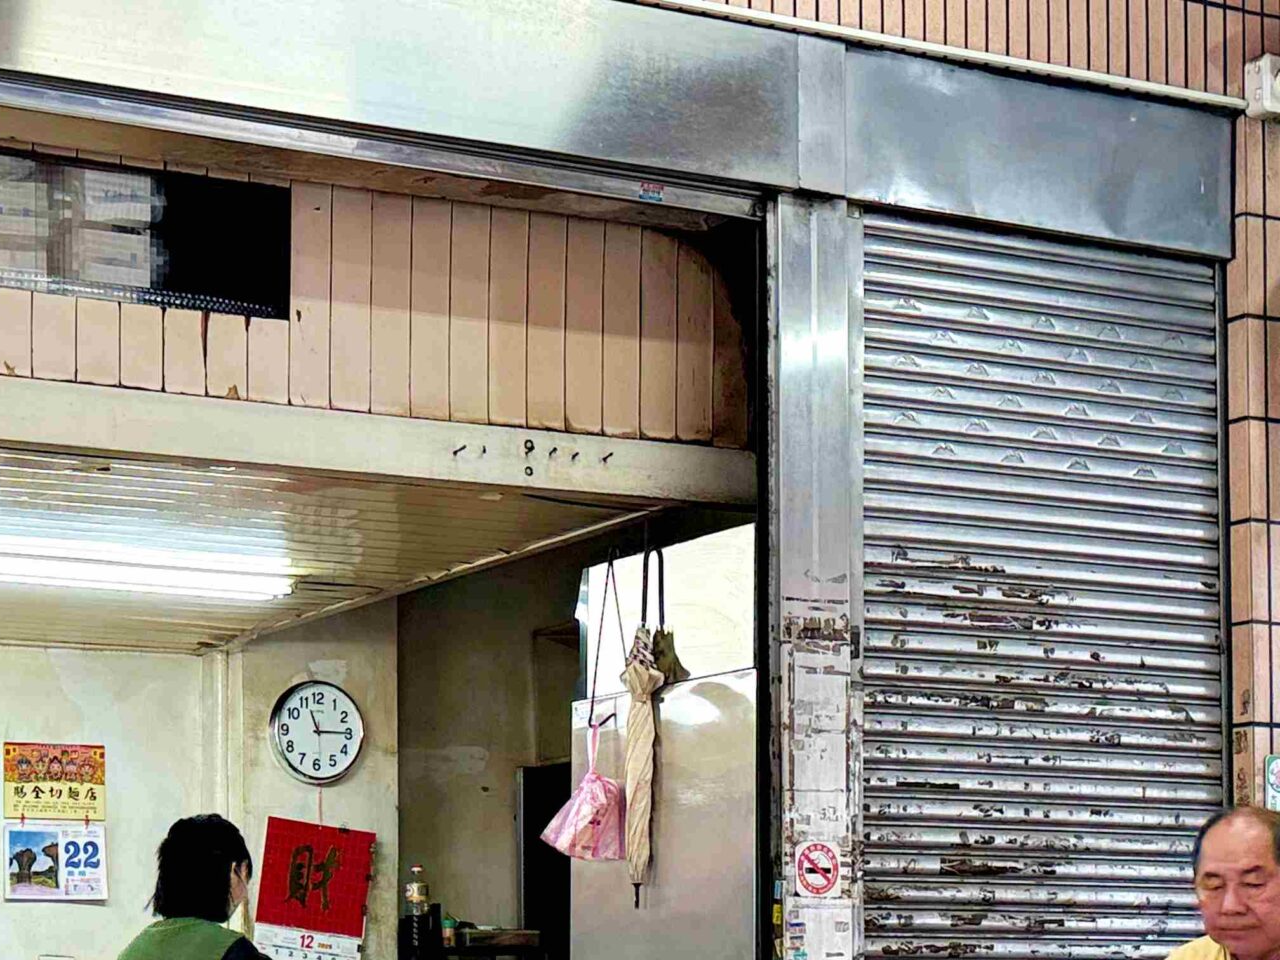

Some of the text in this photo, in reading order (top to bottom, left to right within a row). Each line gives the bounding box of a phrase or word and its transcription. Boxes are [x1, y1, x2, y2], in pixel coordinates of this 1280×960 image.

[299, 696, 308, 709] 11
[312, 692, 324, 704] 12
[332, 698, 337, 711] 1
[287, 707, 300, 720] 10
[340, 711, 348, 723] 2
[281, 723, 289, 736] 9
[344, 727, 353, 740] 3
[286, 740, 294, 753] 8
[340, 743, 348, 756] 4
[298, 752, 306, 765] 7
[313, 758, 321, 771] 6
[329, 754, 337, 767] 5
[64, 841, 100, 868] 22
[300, 935, 314, 949] 12
